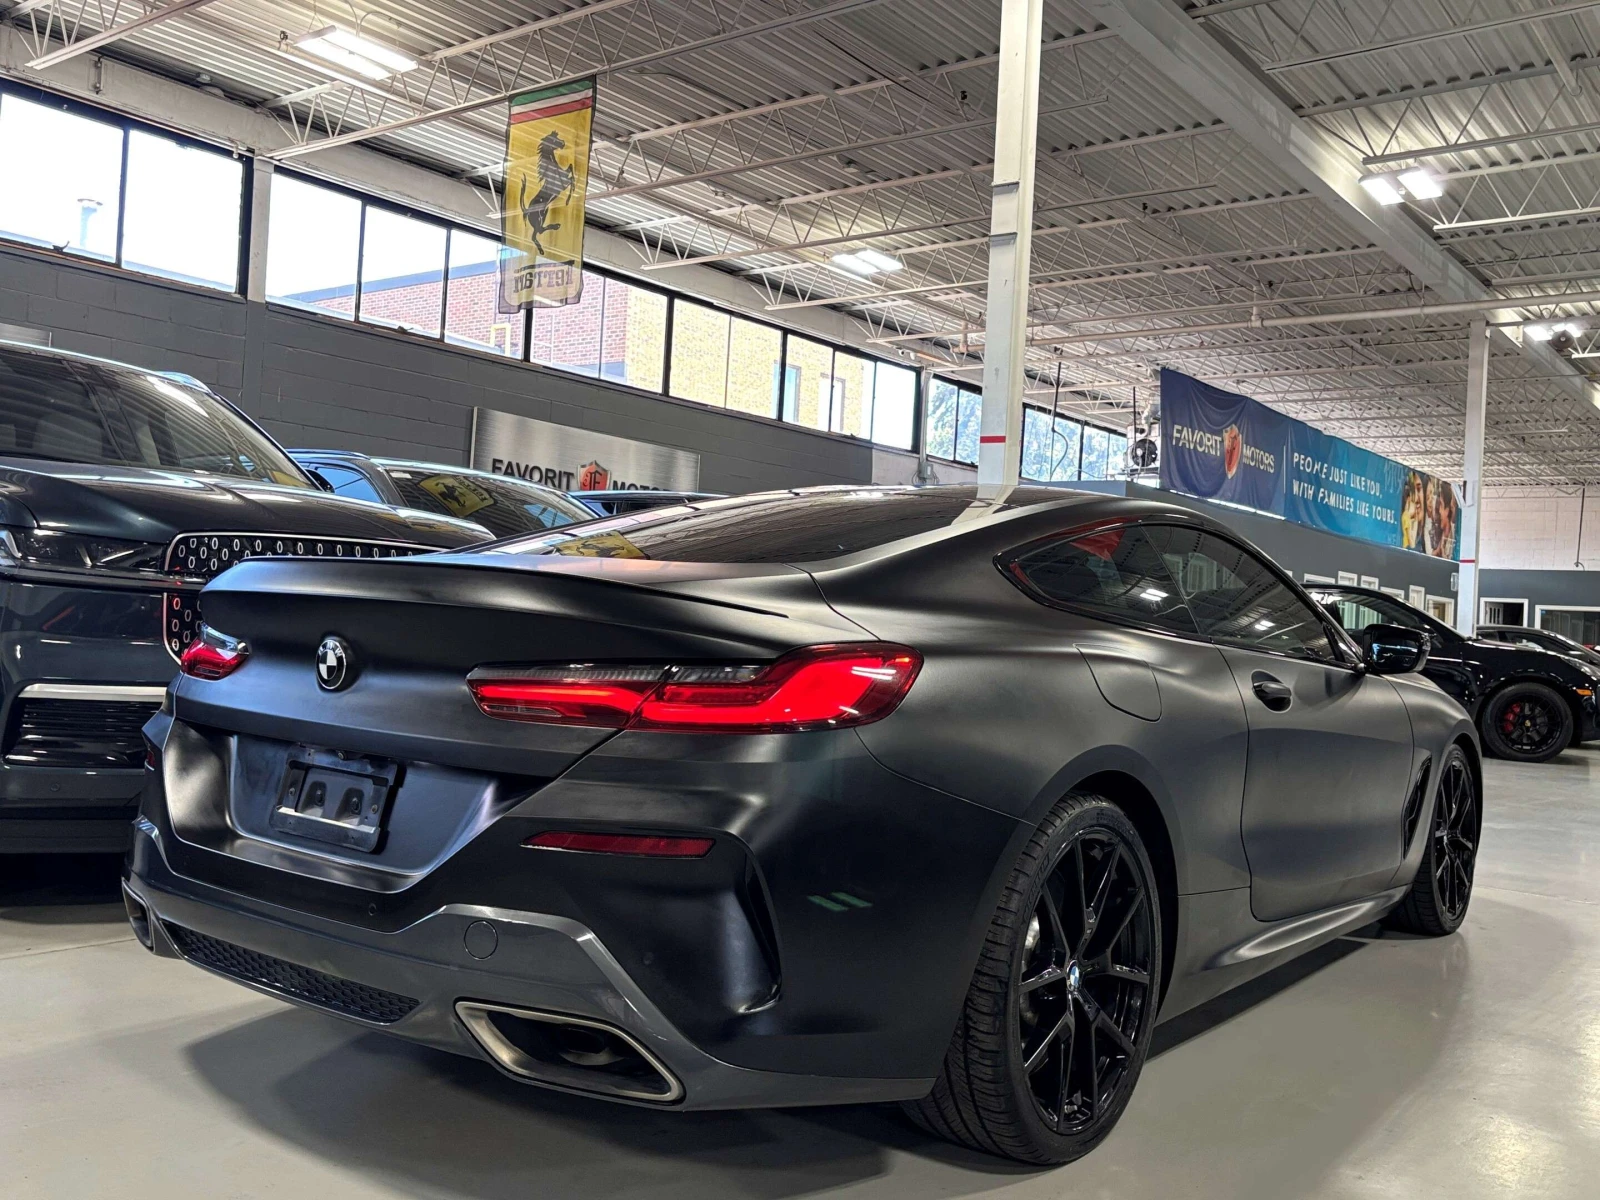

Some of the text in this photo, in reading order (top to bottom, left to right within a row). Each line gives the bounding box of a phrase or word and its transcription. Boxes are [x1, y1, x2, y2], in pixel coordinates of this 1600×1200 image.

[1172, 424, 1275, 474] FAVORIT MOTORS
[491, 457, 575, 491] FAVORIT
[1329, 466, 1348, 485] JUST
[1350, 472, 1365, 491] LIKE
[1292, 479, 1397, 525] WITH FAMILIES LIKE YOURS.
